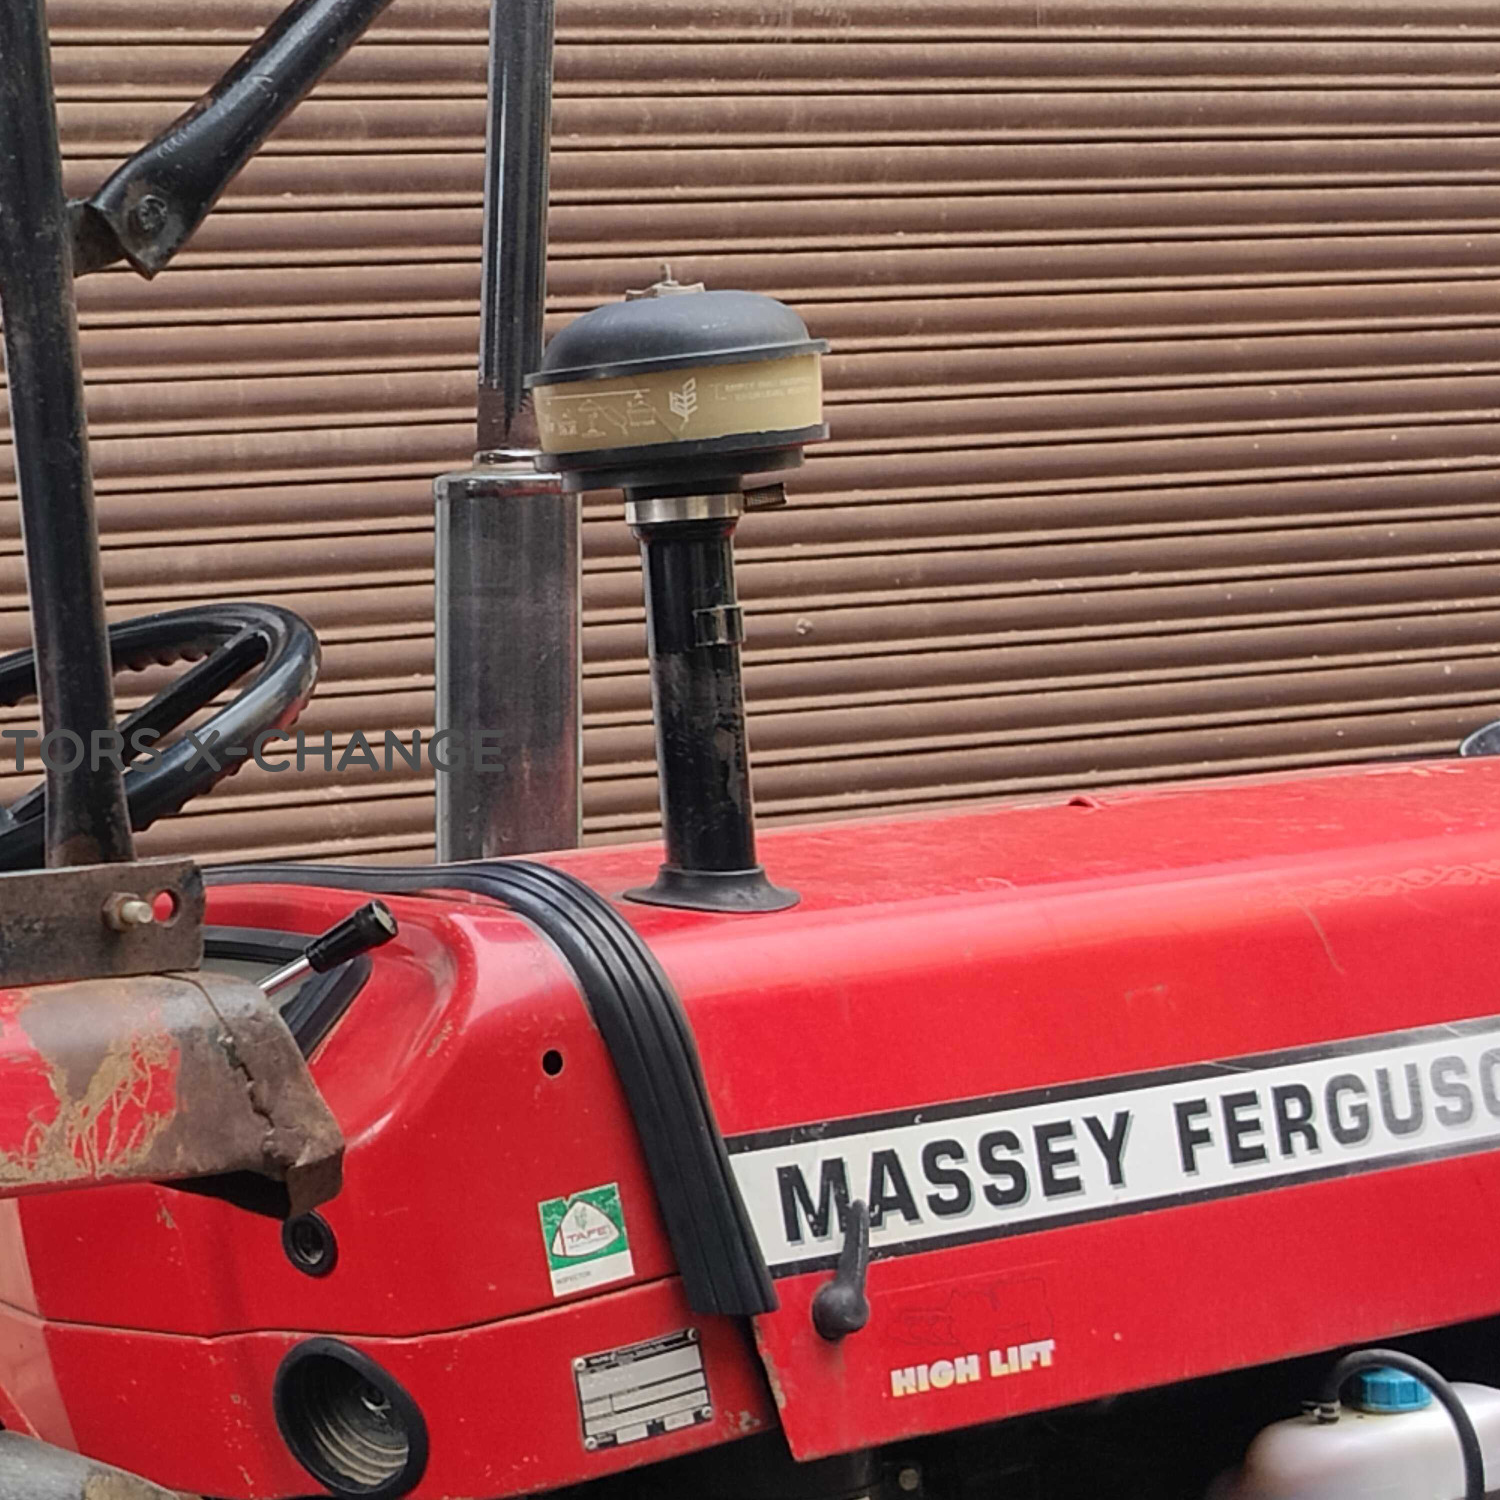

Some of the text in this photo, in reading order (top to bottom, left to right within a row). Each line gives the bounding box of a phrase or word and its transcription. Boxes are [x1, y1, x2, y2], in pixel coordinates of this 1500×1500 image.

[776, 1110, 1133, 1245] MASSEY
[890, 1338, 1056, 1398] HIGH LIFT
